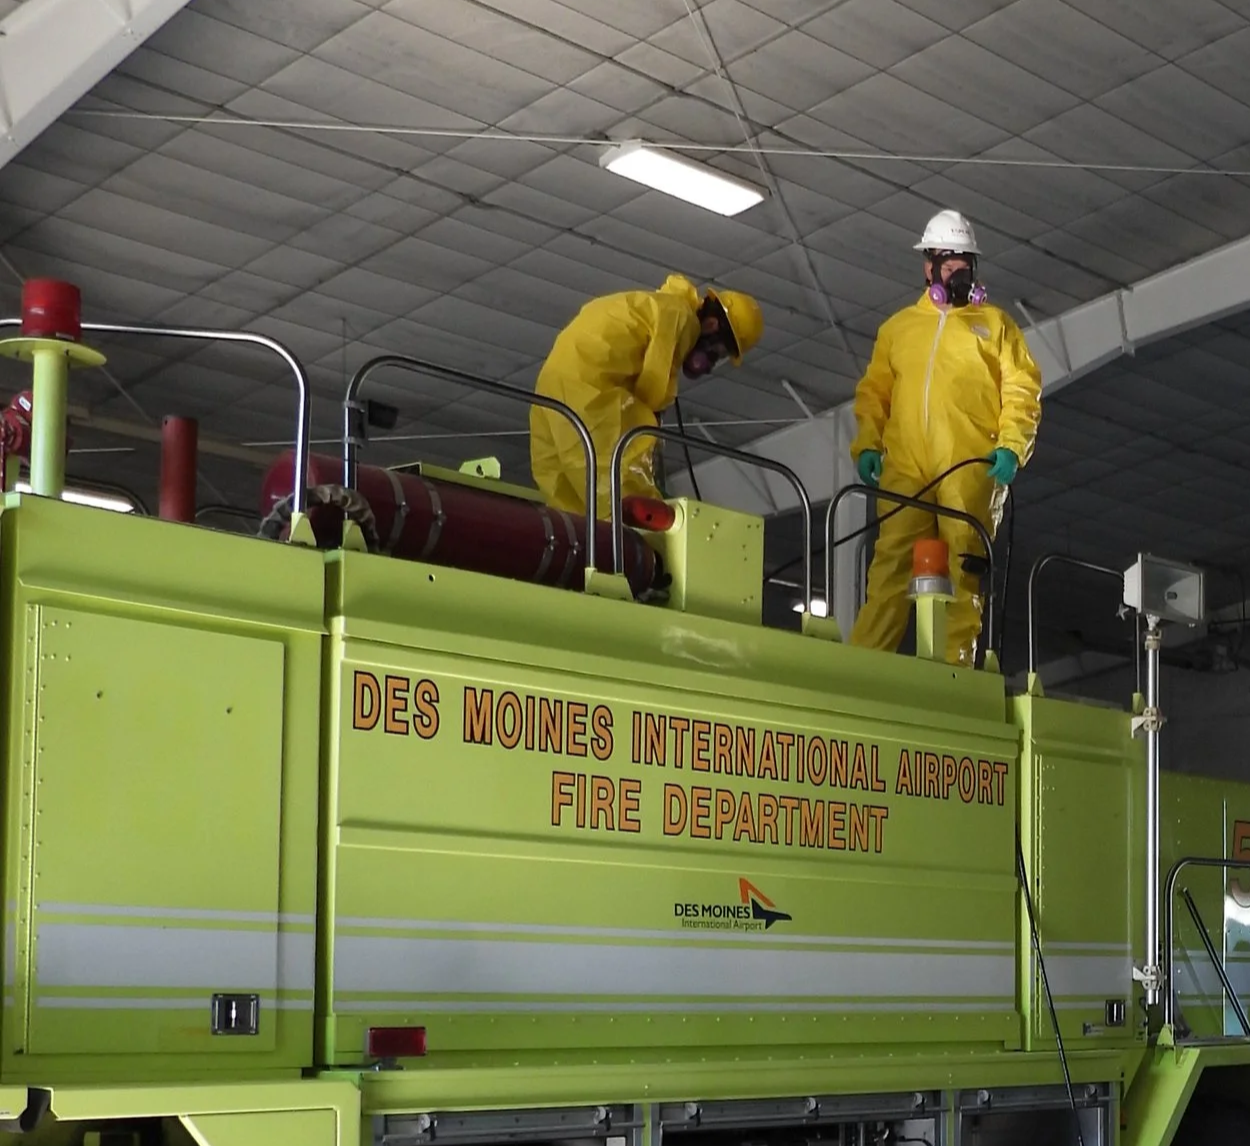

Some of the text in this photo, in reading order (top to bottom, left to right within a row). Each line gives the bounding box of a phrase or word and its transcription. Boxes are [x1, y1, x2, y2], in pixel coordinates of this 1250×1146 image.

[352, 670, 1009, 807] DES MOINES INTERNATIONAL AIRPORT
[551, 770, 889, 854] FIRE DEPARTMENT
[674, 903, 750, 919] DES MOINES
[682, 918, 763, 931] International Airport
